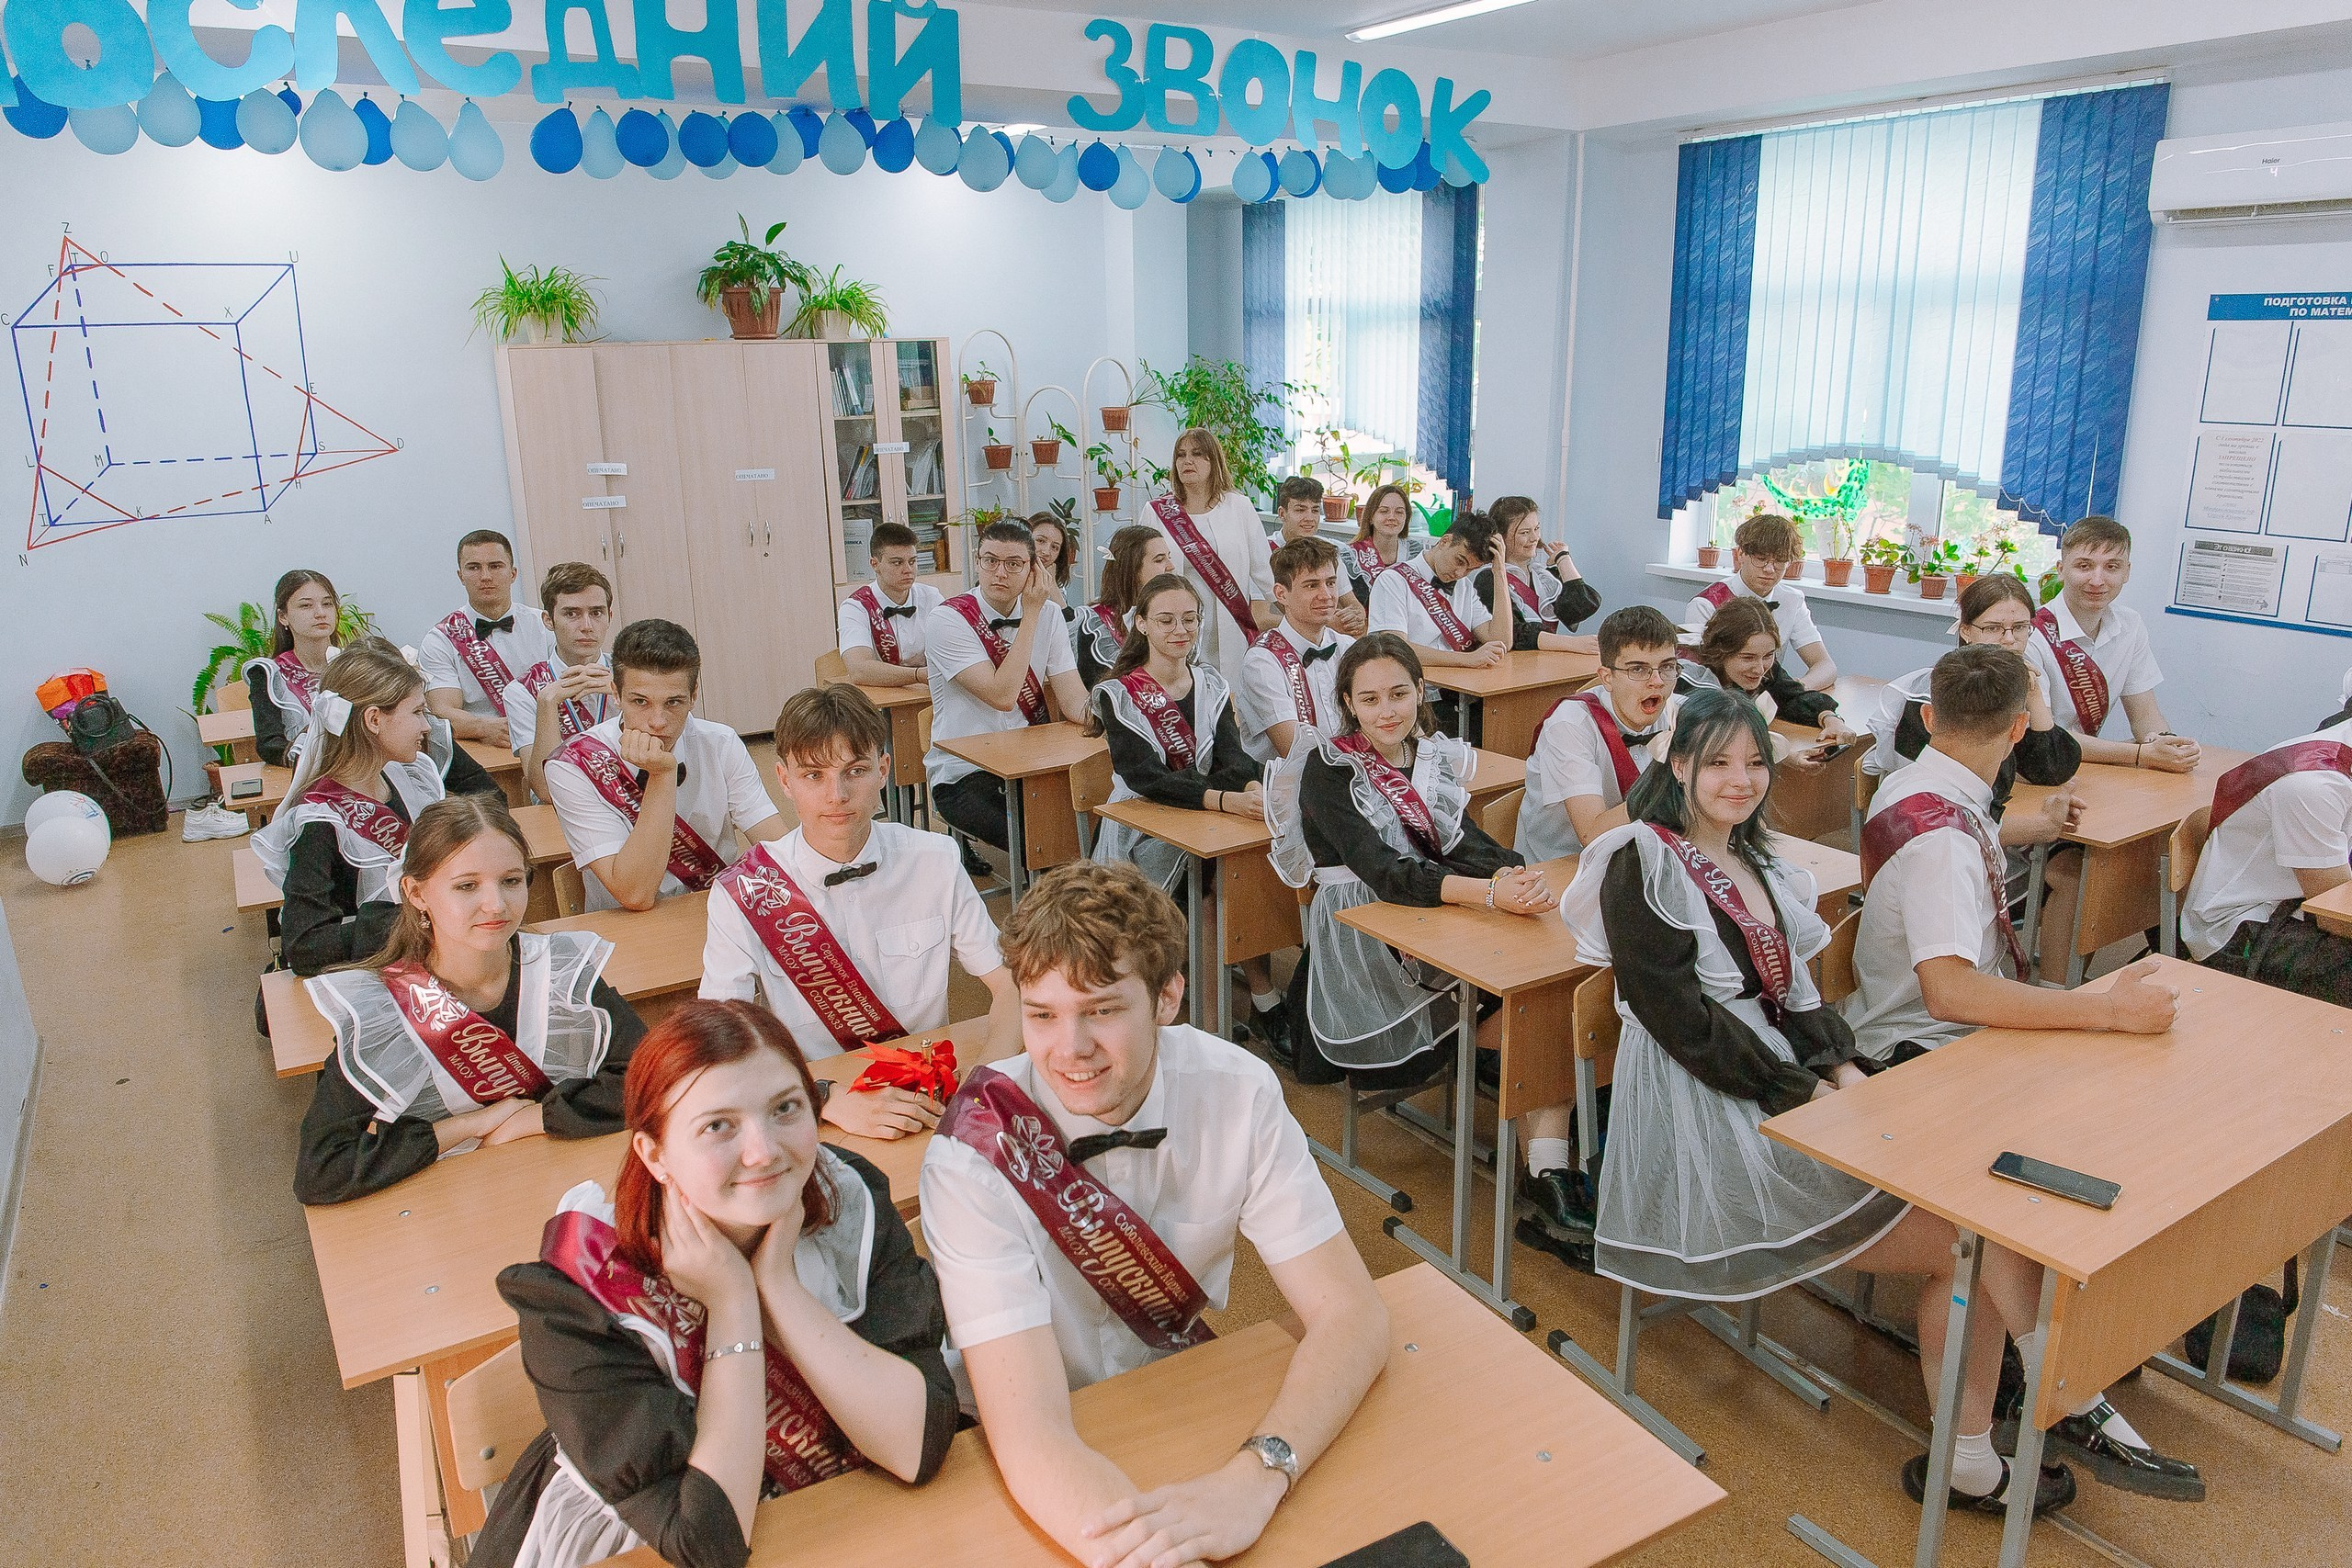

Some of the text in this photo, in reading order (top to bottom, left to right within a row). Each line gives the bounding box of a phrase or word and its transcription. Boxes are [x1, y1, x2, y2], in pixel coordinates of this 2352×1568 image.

[1067, 18, 1492, 186] ЗВОНОК
[2263, 296, 2347, 307] ПОДГОТОВКА
[2289, 307, 2308, 317] ПО
[1417, 581, 1464, 643] Выпускник
[2065, 647, 2102, 722] Выпускник
[1748, 931, 1760, 954] СОШ
[775, 911, 879, 1042] Выпускник
[775, 944, 843, 1031] МАОУ СОШ №33
[820, 942, 881, 1023] Середюк Владислав
[447, 1054, 477, 1080] МАОУ
[1114, 1211, 1169, 1276] Соболевский
